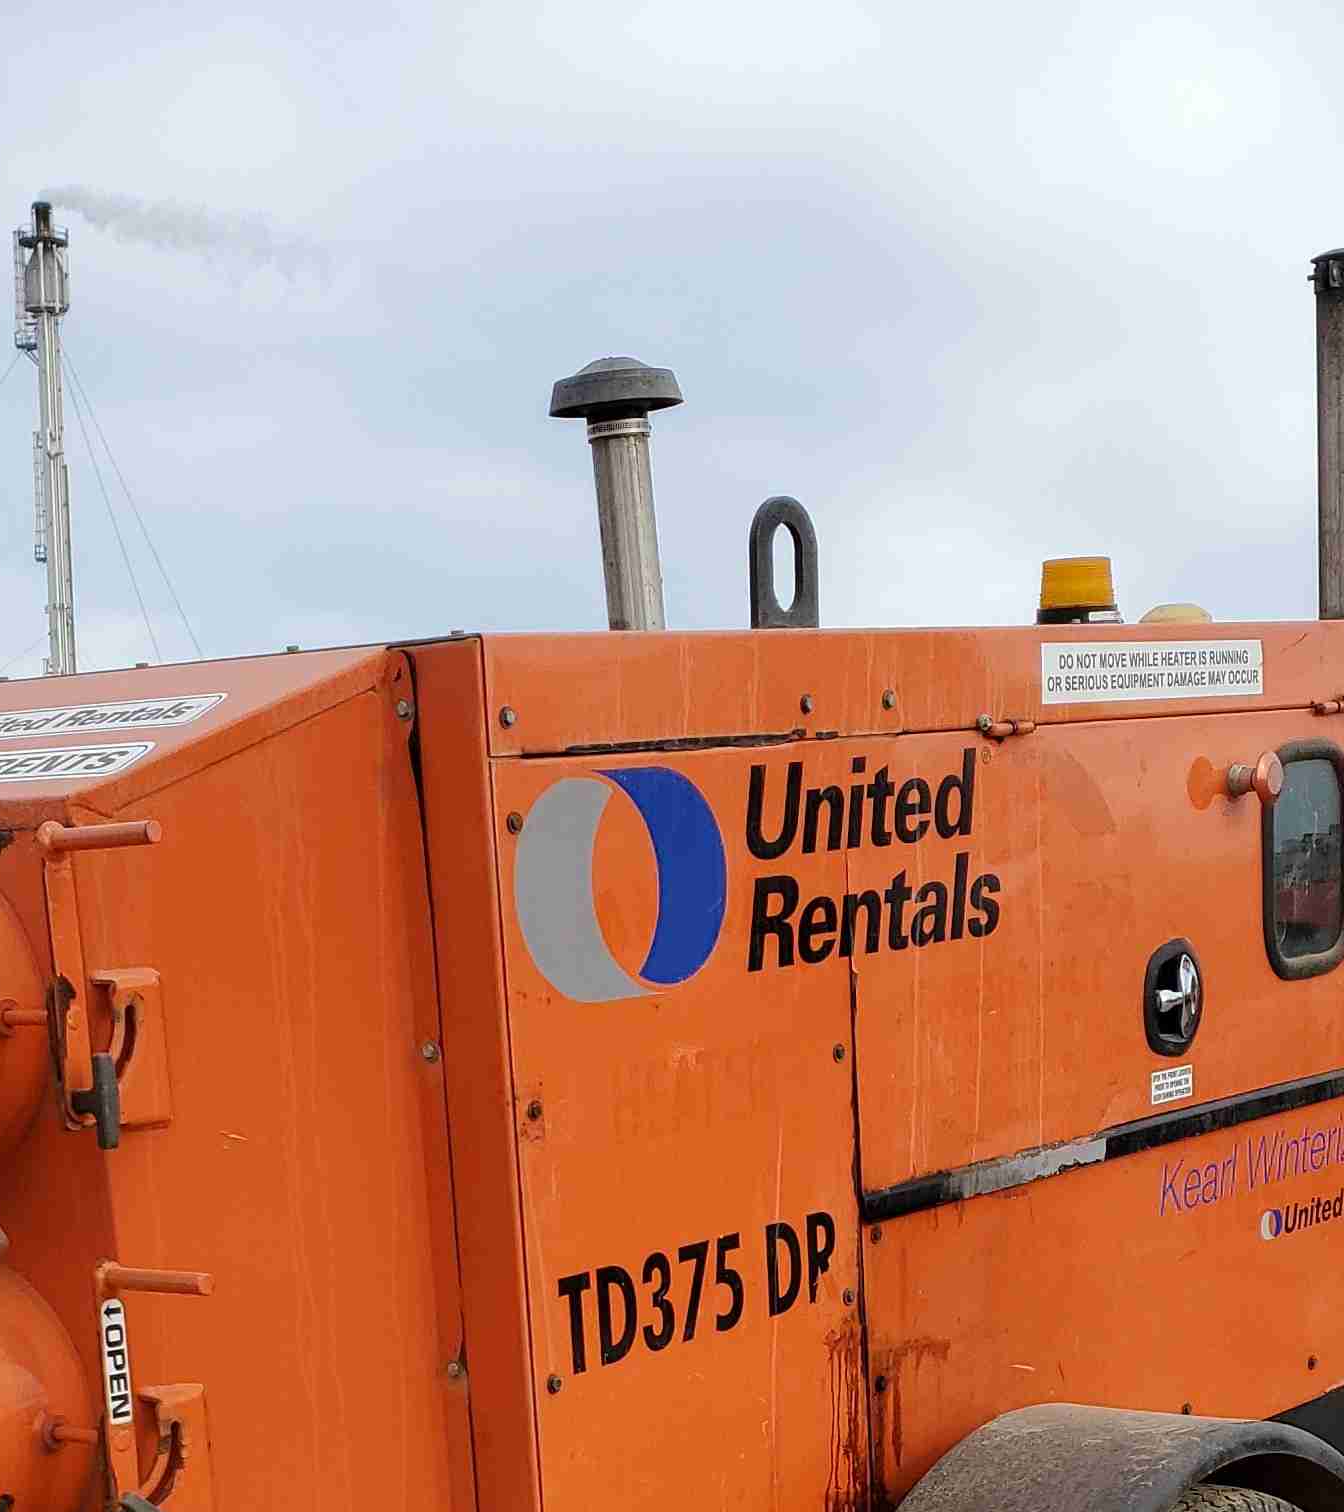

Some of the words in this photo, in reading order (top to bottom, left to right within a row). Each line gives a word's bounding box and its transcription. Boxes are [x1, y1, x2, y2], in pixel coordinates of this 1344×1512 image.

[1047, 676, 1062, 692] OR
[1064, 674, 1109, 691] SERIOUS
[1110, 673, 1165, 690] EQUIPMENT
[1167, 671, 1207, 687] DAMAGE
[1208, 670, 1227, 685] MAY
[1228, 669, 1259, 684] OCCUR
[1059, 654, 1074, 669] DO
[1076, 653, 1097, 669] NOT
[1099, 652, 1127, 668] MOVE
[1129, 651, 1159, 667] WHILE
[1160, 651, 1197, 667] HEATER
[1198, 650, 1207, 665] IS
[1209, 649, 1249, 665] RUNNING
[57, 702, 190, 729] Rentals
[745, 747, 977, 860] United
[747, 852, 1001, 973] Rentals
[1159, 1143, 1237, 1217] Kearl
[1284, 1189, 1343, 1234] United
[558, 1232, 745, 1375] TD375
[105, 1324, 132, 1419] OPEN
